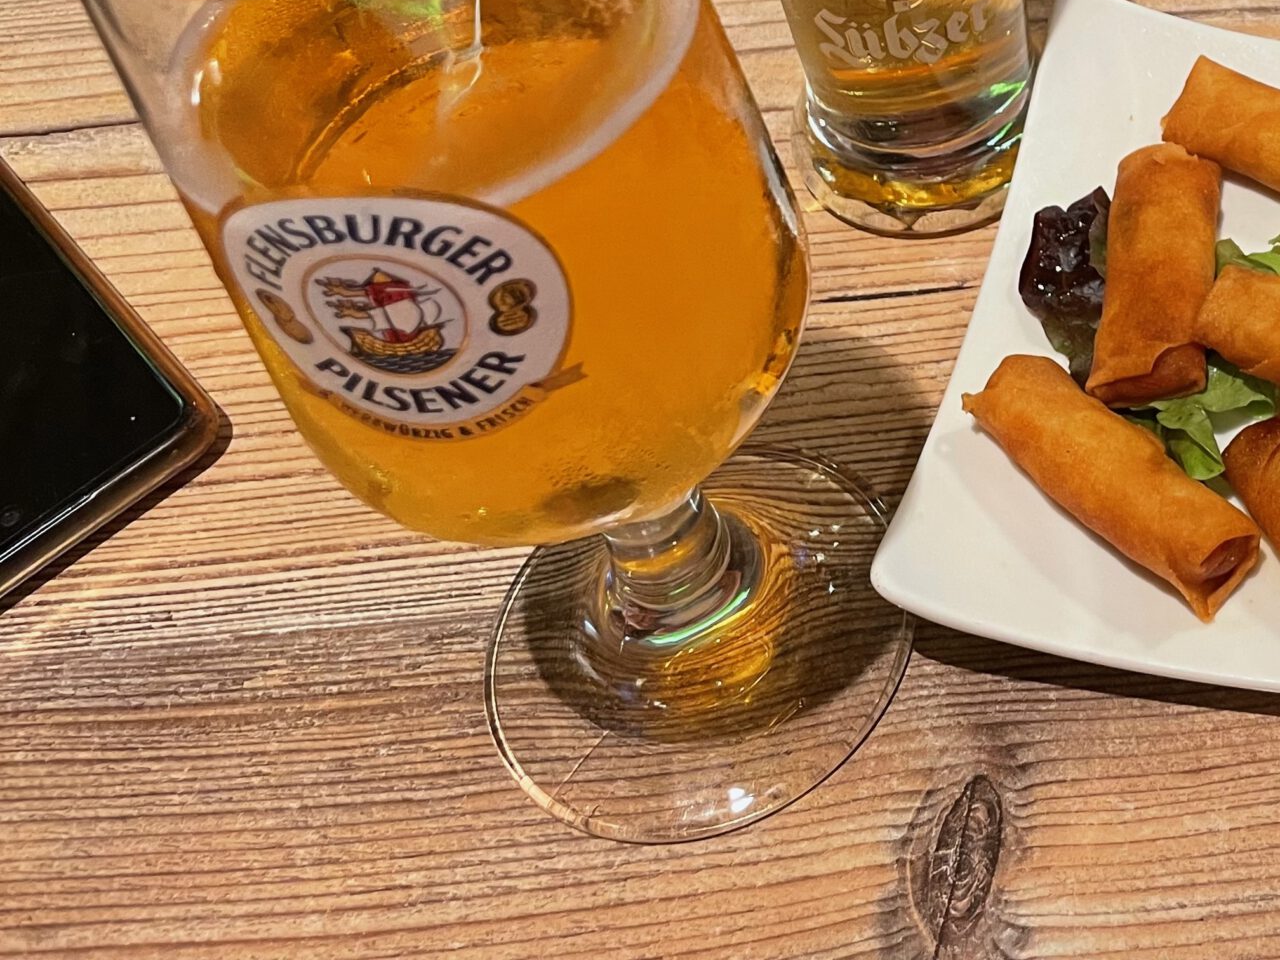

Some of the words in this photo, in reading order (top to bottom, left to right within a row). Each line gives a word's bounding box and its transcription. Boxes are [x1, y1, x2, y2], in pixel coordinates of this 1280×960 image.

[243, 214, 513, 292] FLENSBURGER
[315, 350, 526, 414] PILSENER
[475, 396, 535, 432] FRISCH
